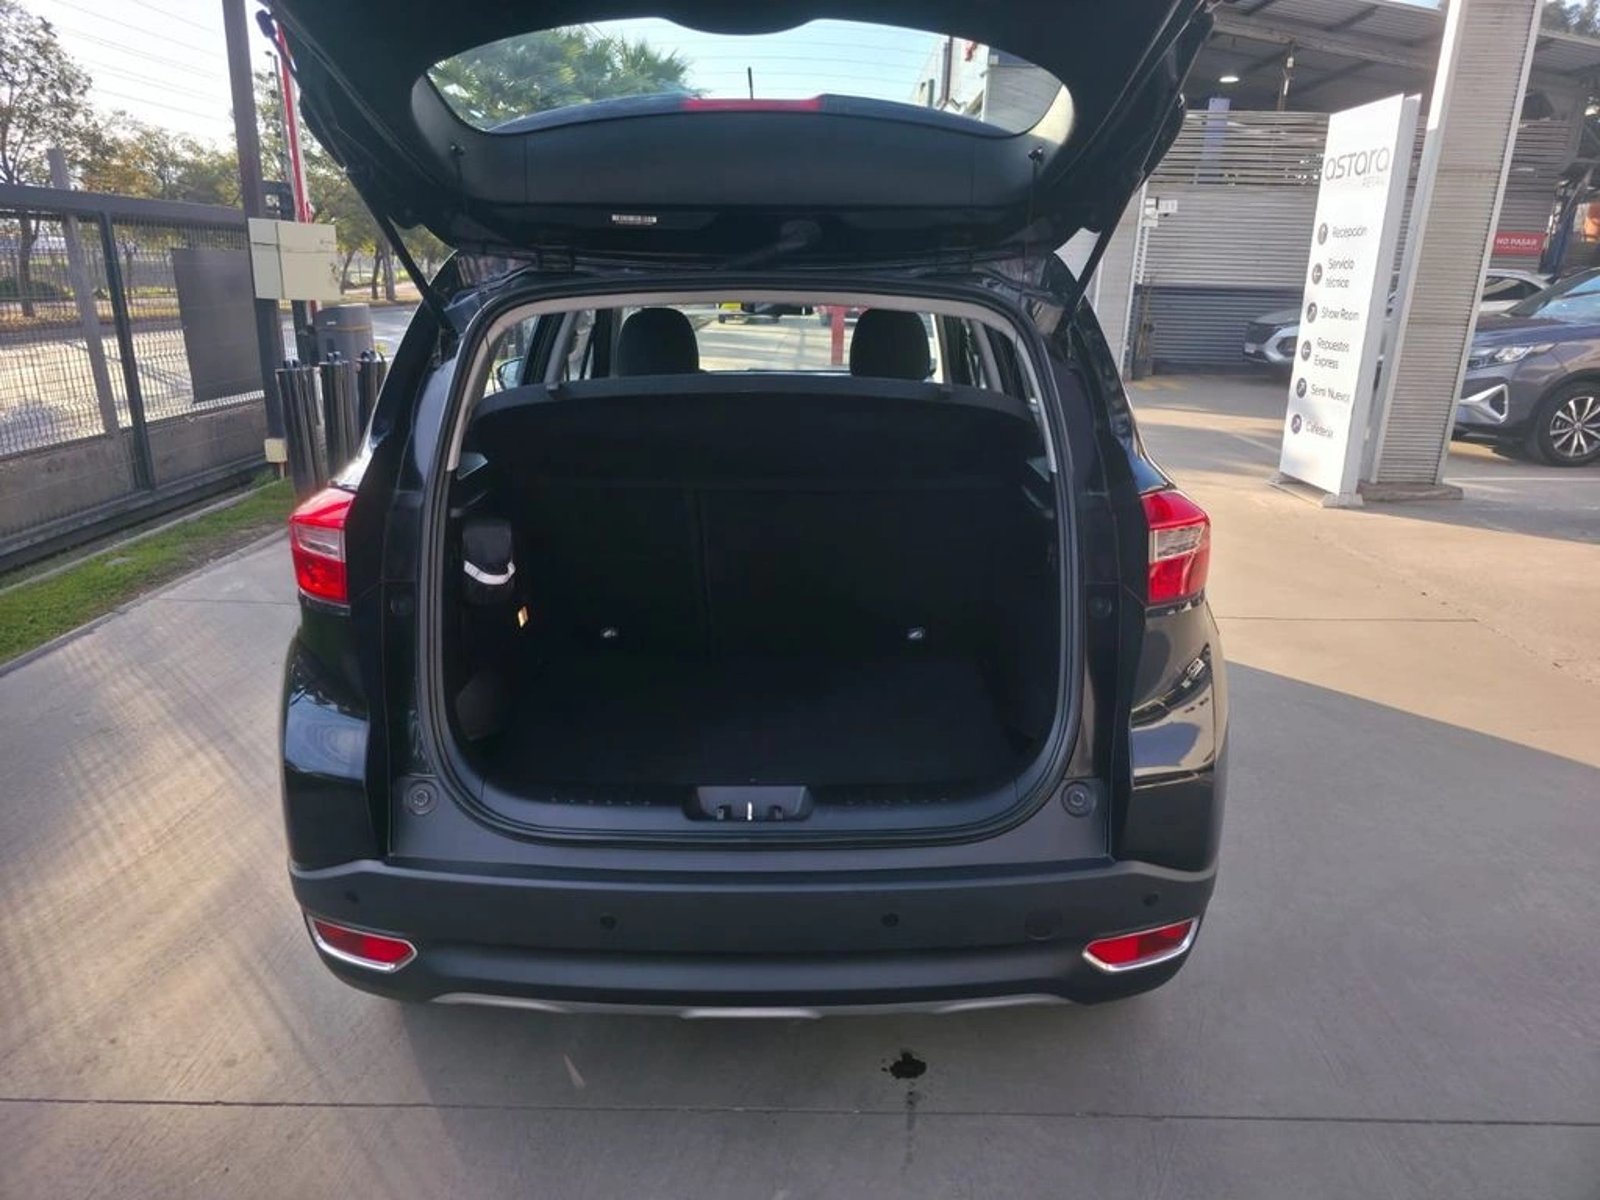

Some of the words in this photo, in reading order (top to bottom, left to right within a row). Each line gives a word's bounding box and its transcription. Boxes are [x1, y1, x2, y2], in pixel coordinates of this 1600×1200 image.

[1325, 147, 1390, 181] astara
[1496, 237, 1509, 245] NO
[1328, 257, 1355, 270] Servicio
[1320, 305, 1339, 319] Show
[1340, 307, 1360, 321] Room
[1314, 353, 1339, 370] Express
[1310, 383, 1326, 397] Semi
